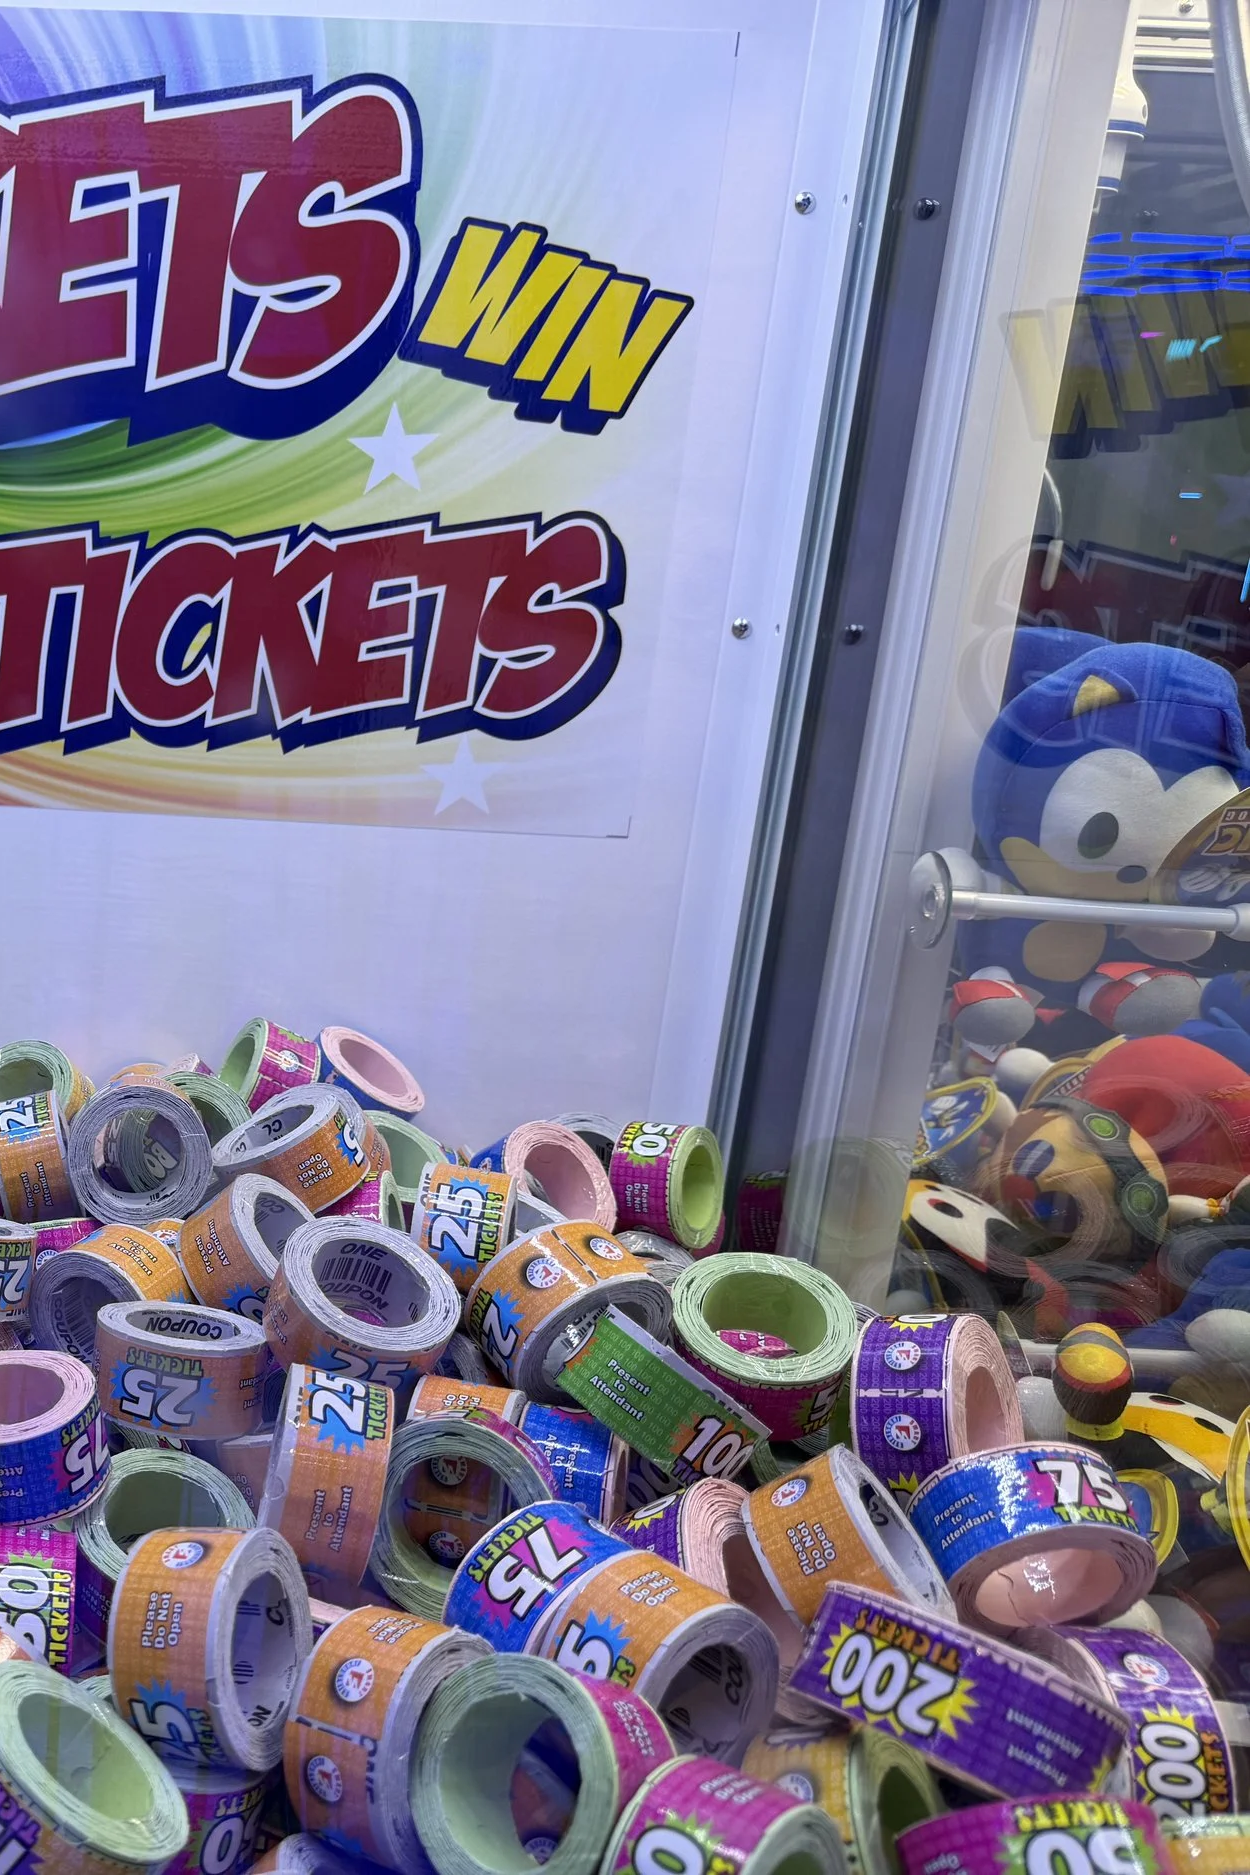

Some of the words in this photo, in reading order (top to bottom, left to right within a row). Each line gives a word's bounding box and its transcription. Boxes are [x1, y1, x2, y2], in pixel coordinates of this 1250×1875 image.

[405, 219, 693, 425] WIN
[631, 1121, 678, 1157] 50
[297, 1168, 315, 1181] Not
[298, 1153, 323, 1170] Open
[302, 1169, 334, 1188] Please
[315, 1159, 329, 1171] Do
[429, 1182, 486, 1259] 25
[341, 1243, 387, 1260] ONE
[146, 1316, 223, 1340] COUPON
[126, 1346, 205, 1377] TICKETS
[608, 1359, 650, 1395] Present
[120, 1366, 205, 1427] 25
[588, 1375, 645, 1421] Attendant
[613, 1377, 626, 1390] to
[310, 1370, 367, 1436] 25
[681, 1415, 754, 1481] 100
[1033, 1459, 1129, 1511] 75
[307, 1489, 327, 1542] Present
[324, 1513, 334, 1528] to
[330, 1486, 354, 1553] Attendant
[933, 1492, 976, 1528] Present
[950, 1512, 963, 1524] to
[466, 1512, 545, 1583] TICKETS
[796, 1521, 816, 1547] Not
[813, 1522, 836, 1561] Open
[939, 1509, 996, 1550] Attendant
[786, 1527, 815, 1576] Please
[811, 1549, 827, 1571] Do
[485, 1526, 586, 1621] 75
[620, 1568, 661, 1596] Please
[630, 1587, 650, 1604] Do
[651, 1575, 675, 1594] Not
[157, 1591, 173, 1621] Not
[644, 1584, 680, 1608] Open
[49, 1571, 75, 1667] TICKETS
[141, 1591, 159, 1649] Please
[167, 1601, 184, 1647] Open
[153, 1629, 166, 1650] Do
[855, 1608, 962, 1675] TICKETS
[829, 1632, 958, 1737] 200
[1024, 1827, 1143, 1875] 50
